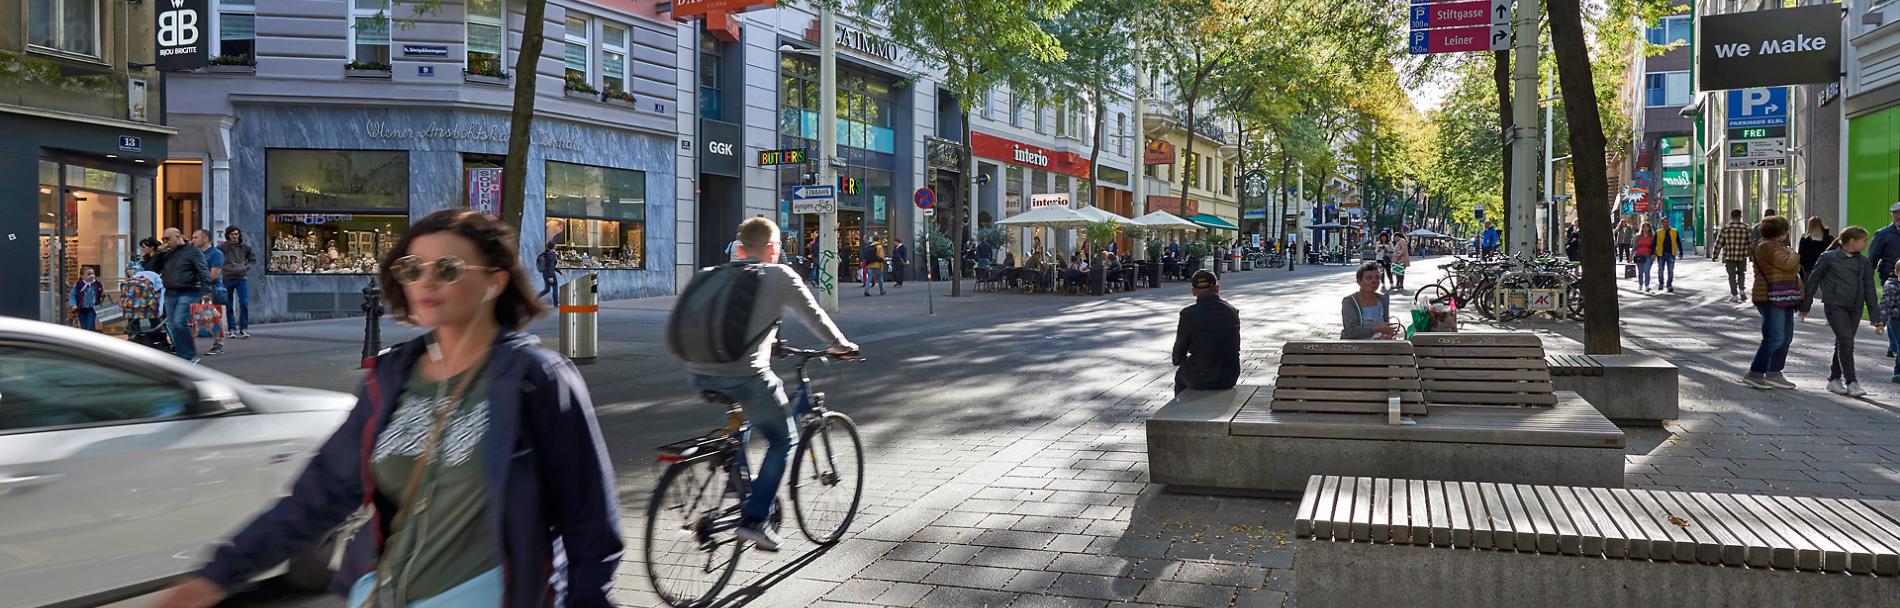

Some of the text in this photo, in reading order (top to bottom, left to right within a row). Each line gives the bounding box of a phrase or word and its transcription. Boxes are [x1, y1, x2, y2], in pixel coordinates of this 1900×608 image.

[1437, 9, 1484, 20] Stiftgasse
[855, 30, 898, 62] IMMO
[1444, 36, 1473, 46] Leiner
[159, 46, 197, 57] BIJOU BRIGITTE
[1743, 129, 1766, 138] FREI
[124, 137, 136, 147] 13
[709, 141, 733, 156] GGK
[762, 149, 806, 165] BUTLERS
[1014, 144, 1048, 167] interio
[1032, 196, 1069, 207] interio
[1534, 295, 1549, 305] AK
